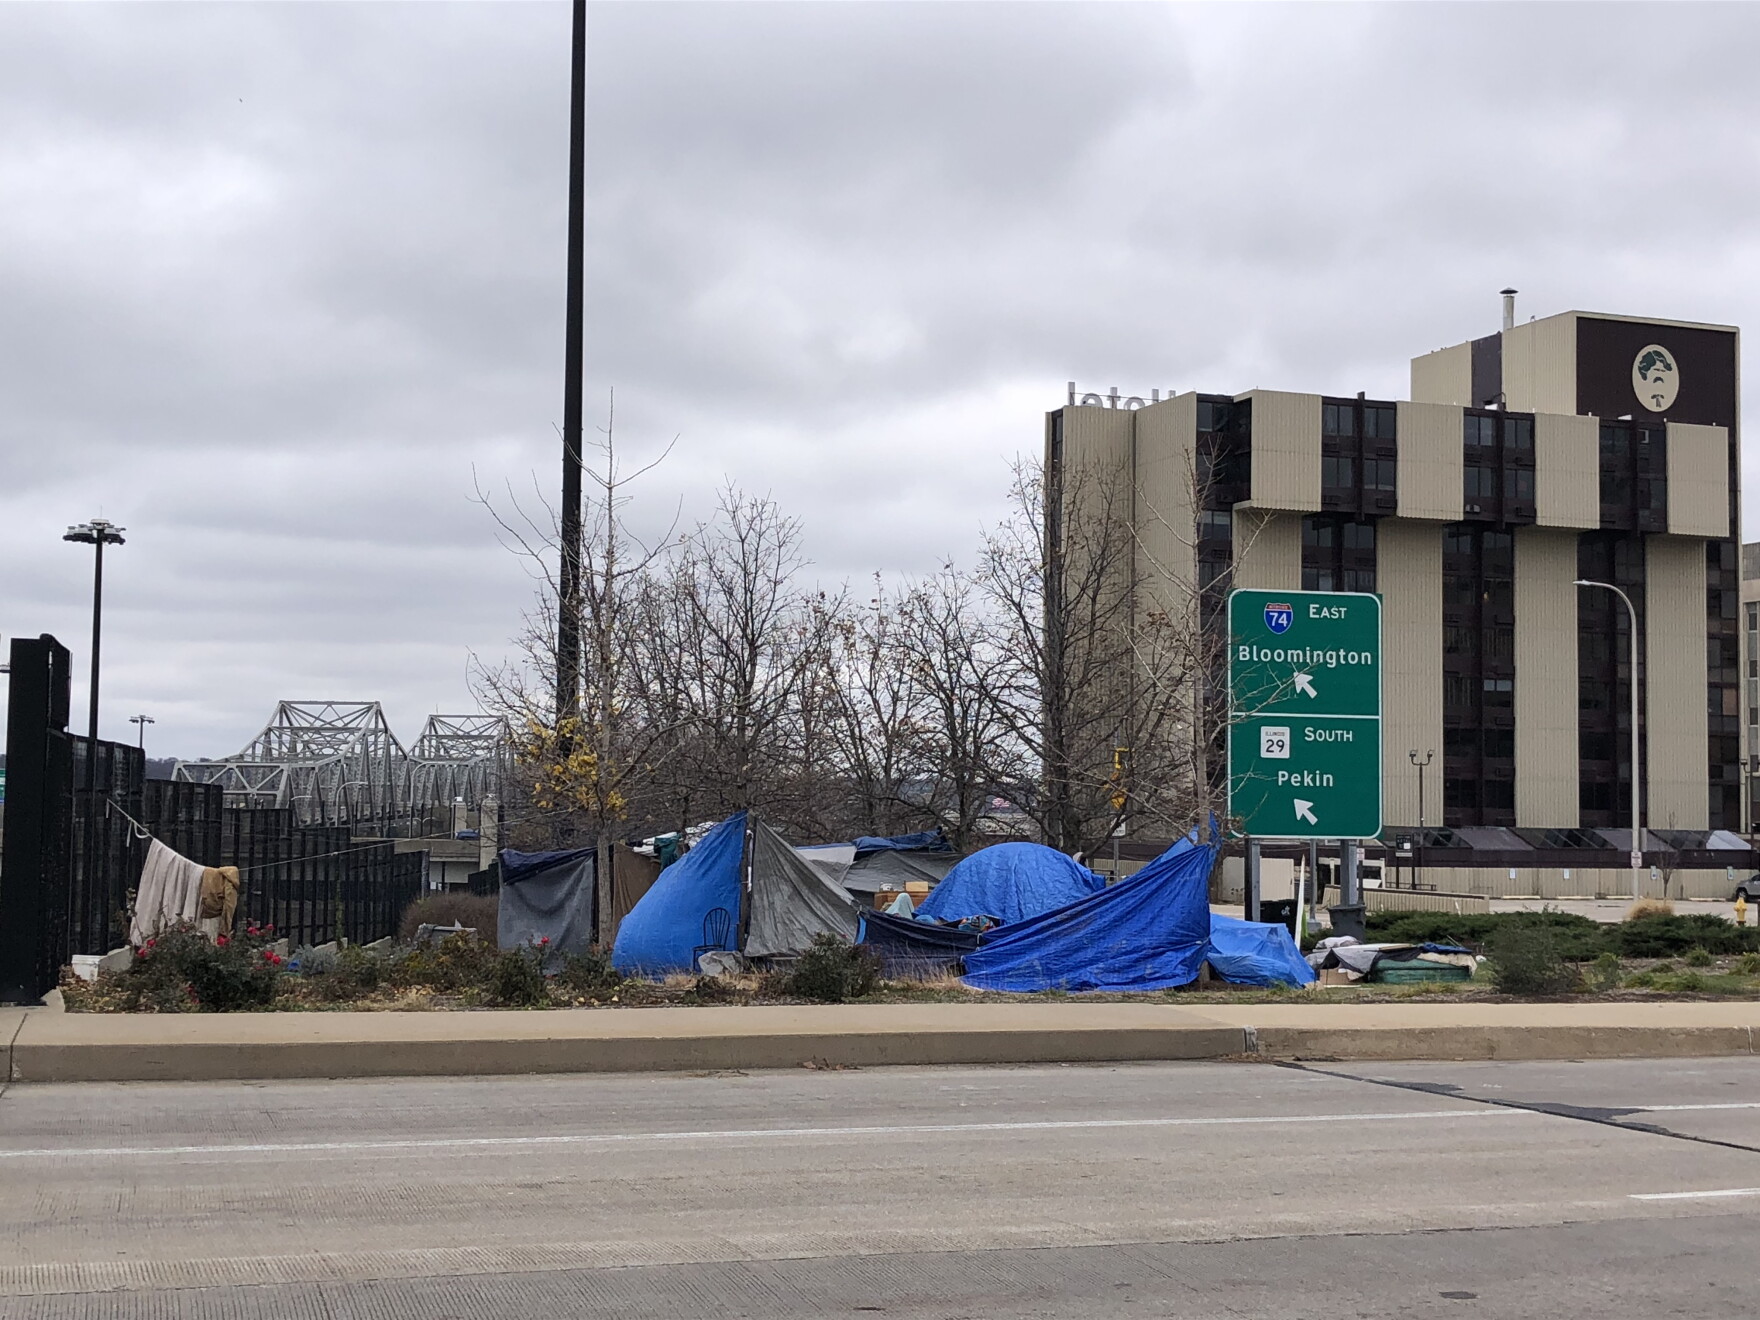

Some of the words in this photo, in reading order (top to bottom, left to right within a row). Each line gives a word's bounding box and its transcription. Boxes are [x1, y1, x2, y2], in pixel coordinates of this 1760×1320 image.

[1309, 604, 1347, 619] EAST
[1269, 612, 1288, 627] 74
[1239, 645, 1372, 668] Bloomington
[1304, 727, 1353, 742] SOUTH
[1265, 739, 1285, 753] 29
[1277, 770, 1334, 787] Pekin
